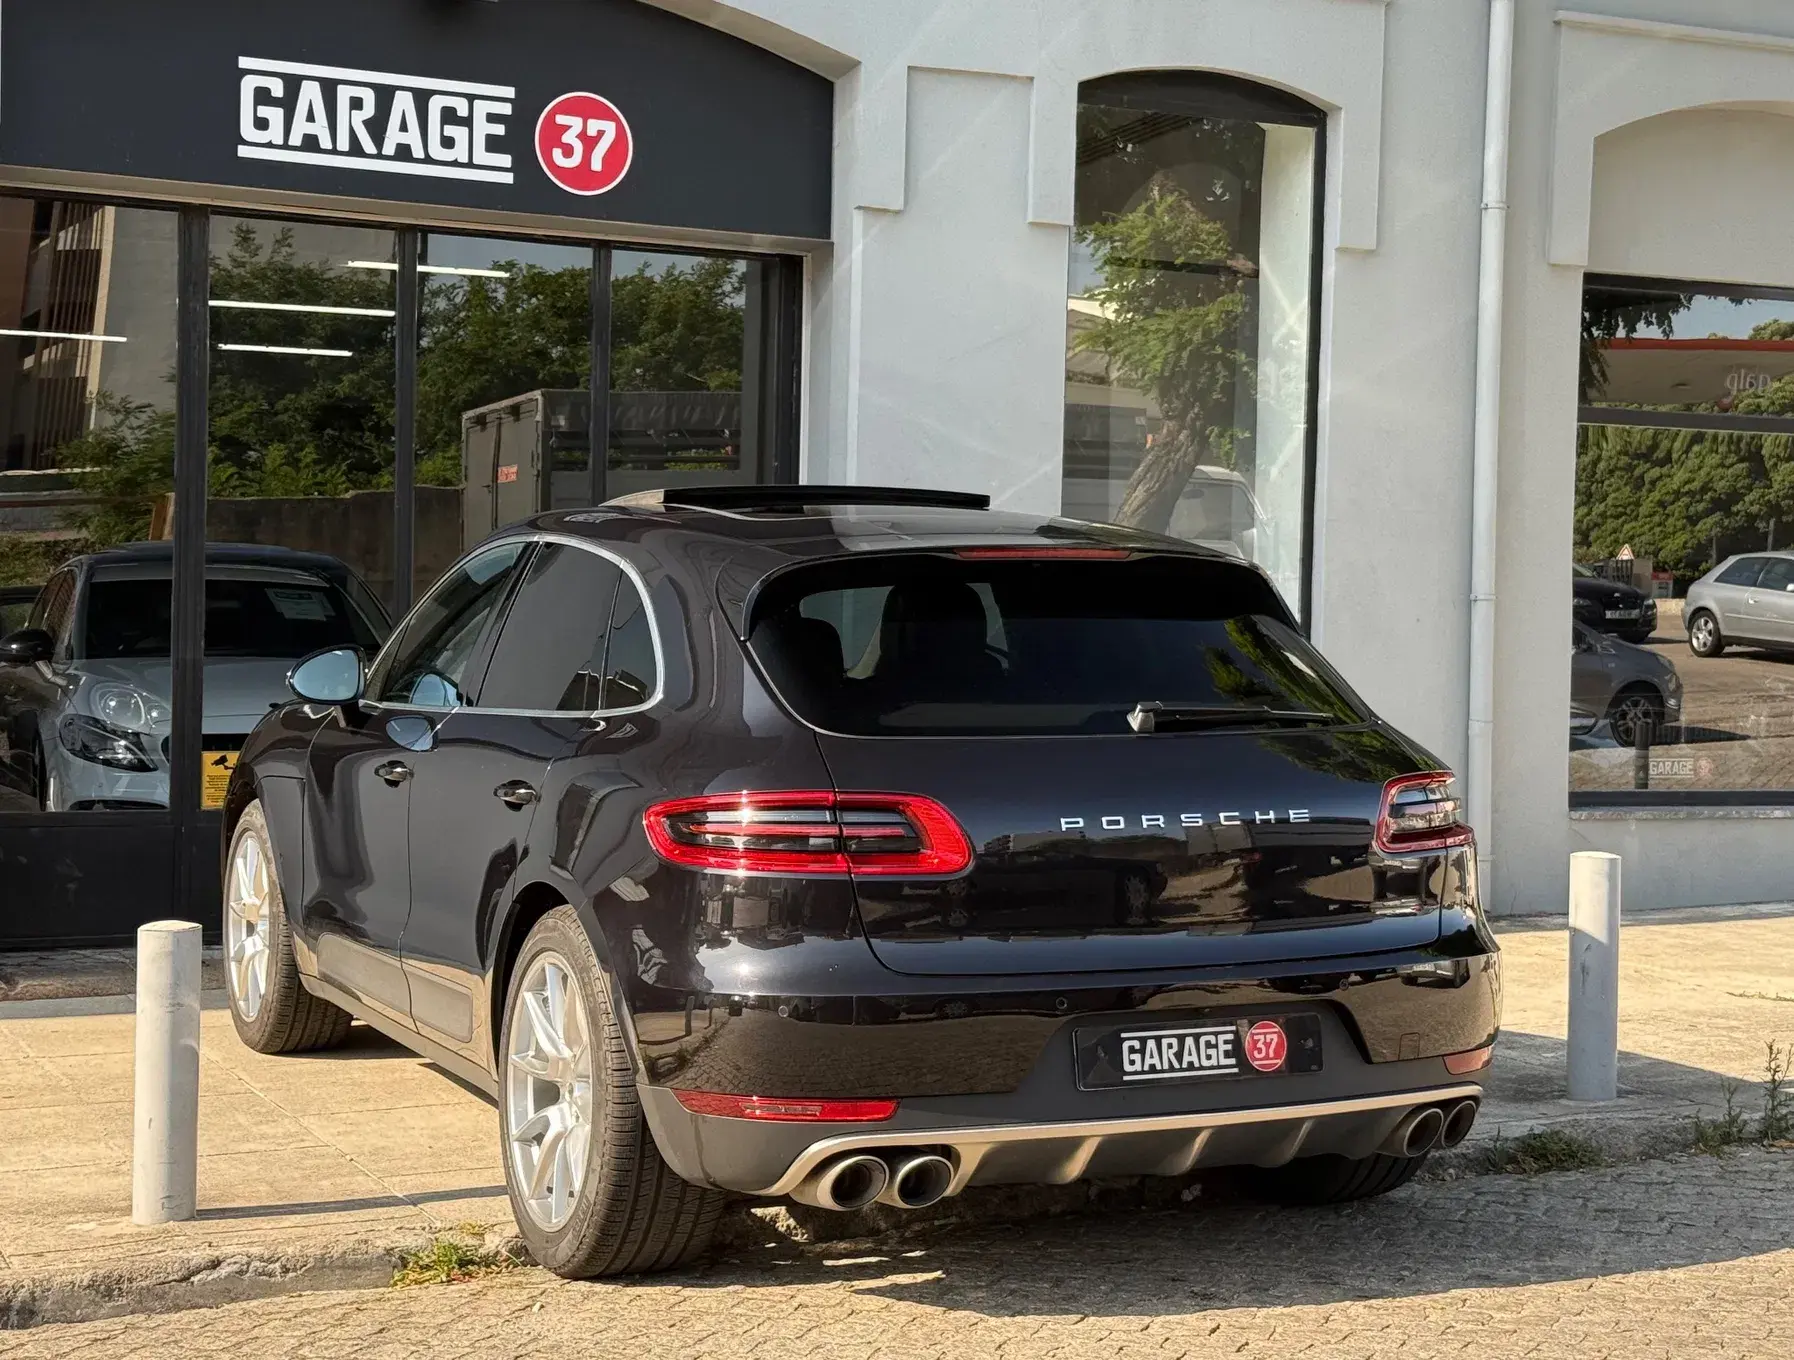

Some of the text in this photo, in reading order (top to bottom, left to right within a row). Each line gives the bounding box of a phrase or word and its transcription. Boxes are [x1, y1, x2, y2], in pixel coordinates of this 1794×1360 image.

[240, 74, 616, 172] GARAGE 37
[1649, 761, 1694, 775] GARAGE
[1060, 809, 1310, 831] PORSCHE
[1122, 1033, 1278, 1073] GARAGE 37
